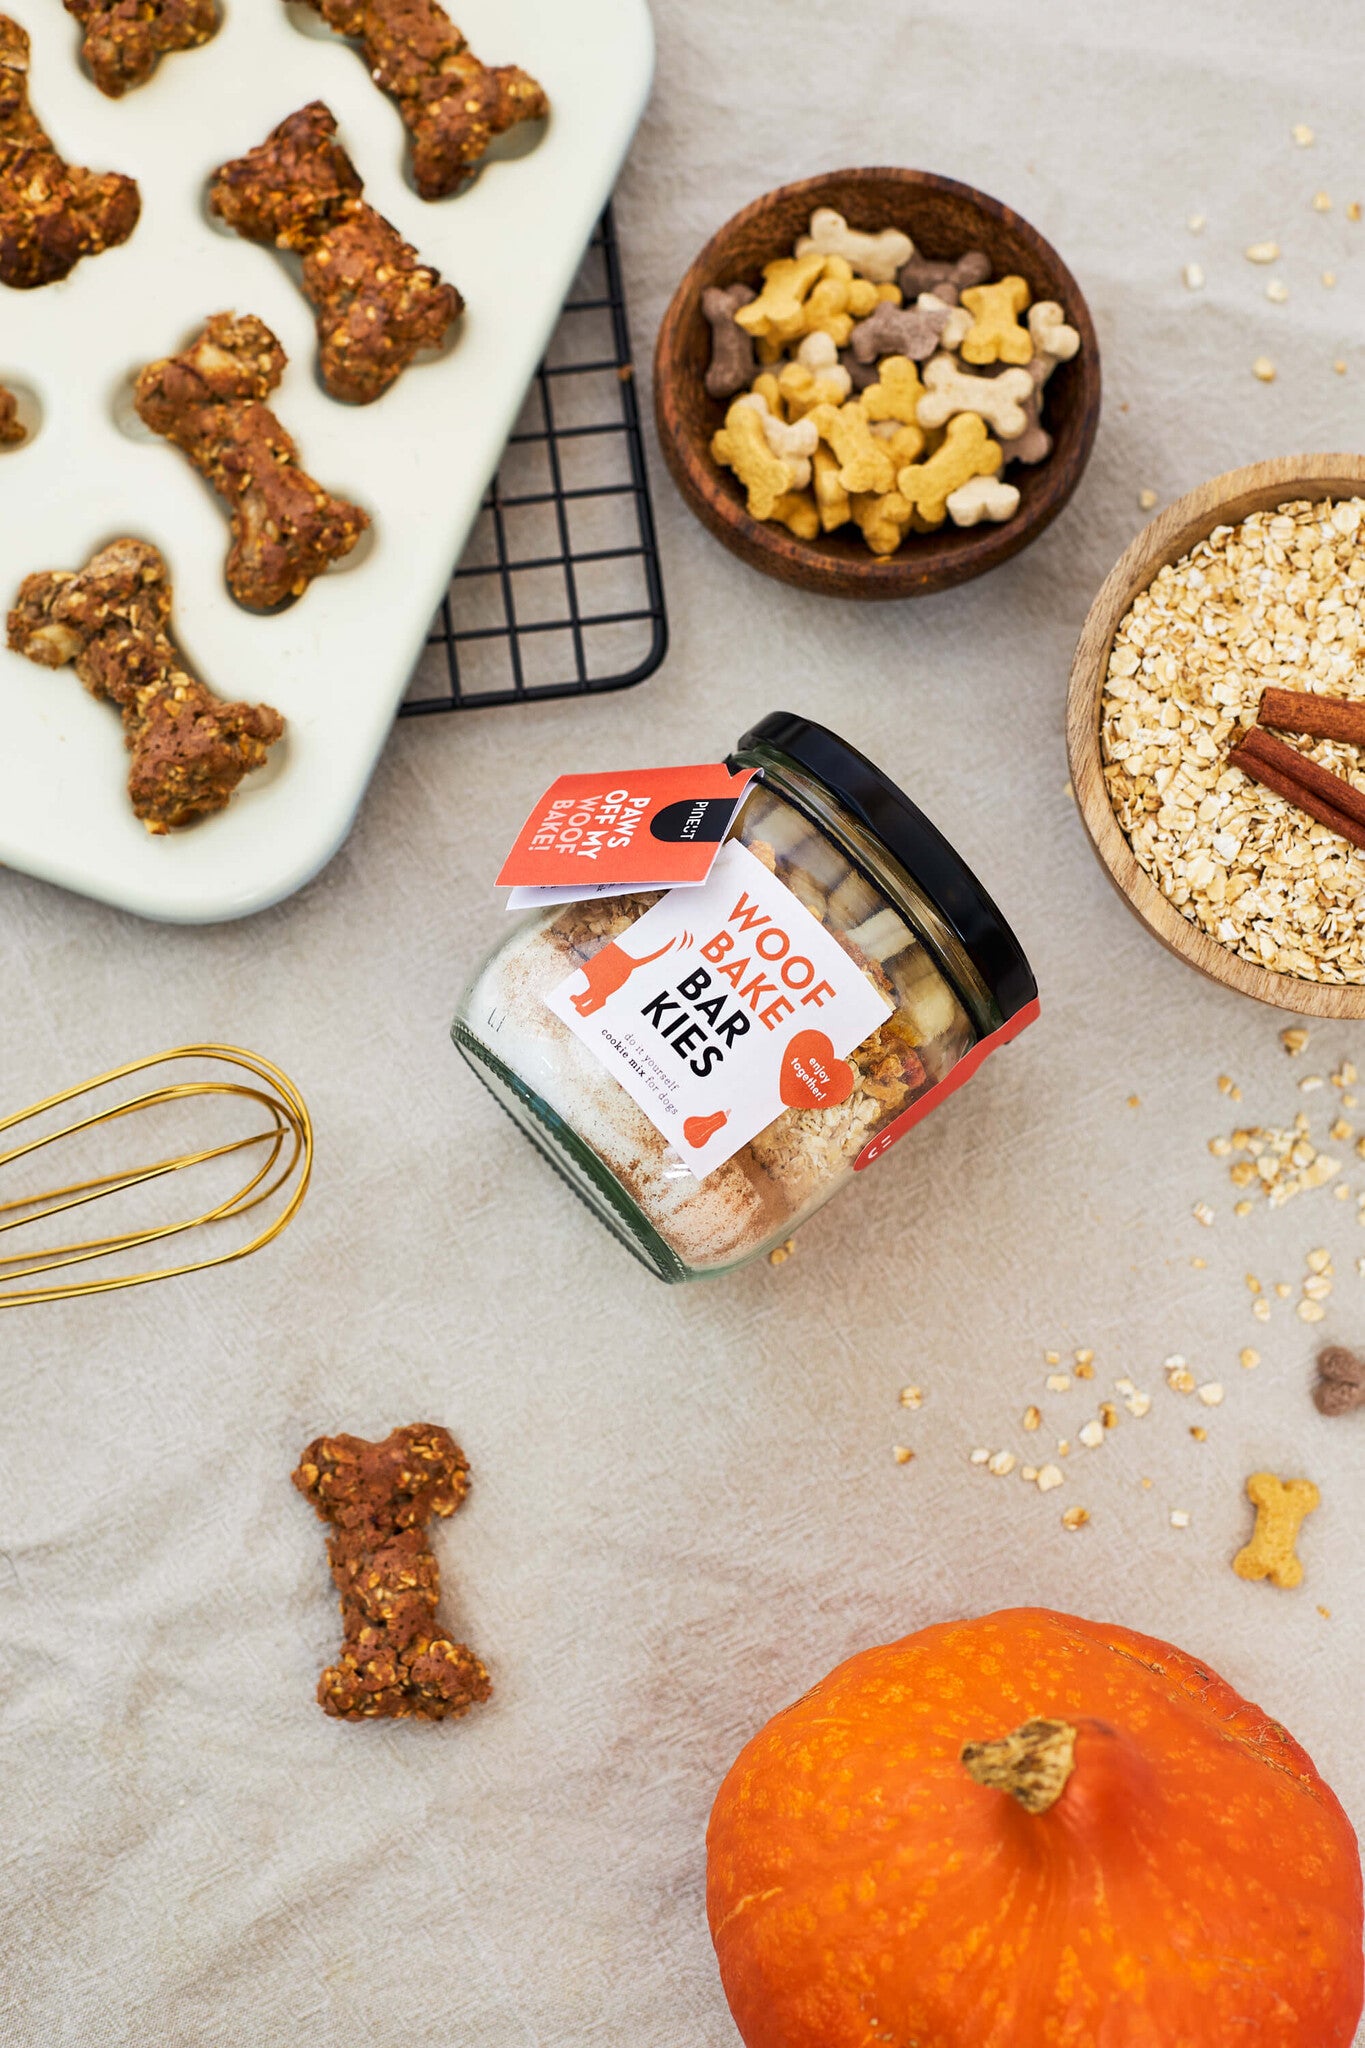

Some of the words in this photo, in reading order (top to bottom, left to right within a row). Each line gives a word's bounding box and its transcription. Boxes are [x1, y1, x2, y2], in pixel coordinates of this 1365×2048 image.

[528, 799, 572, 851] BAKE!
[554, 795, 603, 854] WOOF
[594, 789, 628, 825] OFF
[606, 797, 651, 848] PAWS
[577, 830, 609, 860] MY
[728, 891, 837, 1008] WOOF
[676, 966, 751, 1049] BAR
[699, 930, 795, 1031] BAKE
[624, 1034, 636, 1046] do
[635, 1046, 644, 1055] it
[641, 1055, 680, 1092] yourself
[640, 990, 724, 1078] KIES
[601, 1029, 629, 1058] cookie
[628, 1058, 646, 1077] mix
[645, 1076, 659, 1092] for
[658, 1092, 679, 1115] dogs
[790, 1057, 827, 1101] together!
[809, 1057, 830, 1084] enjoy
